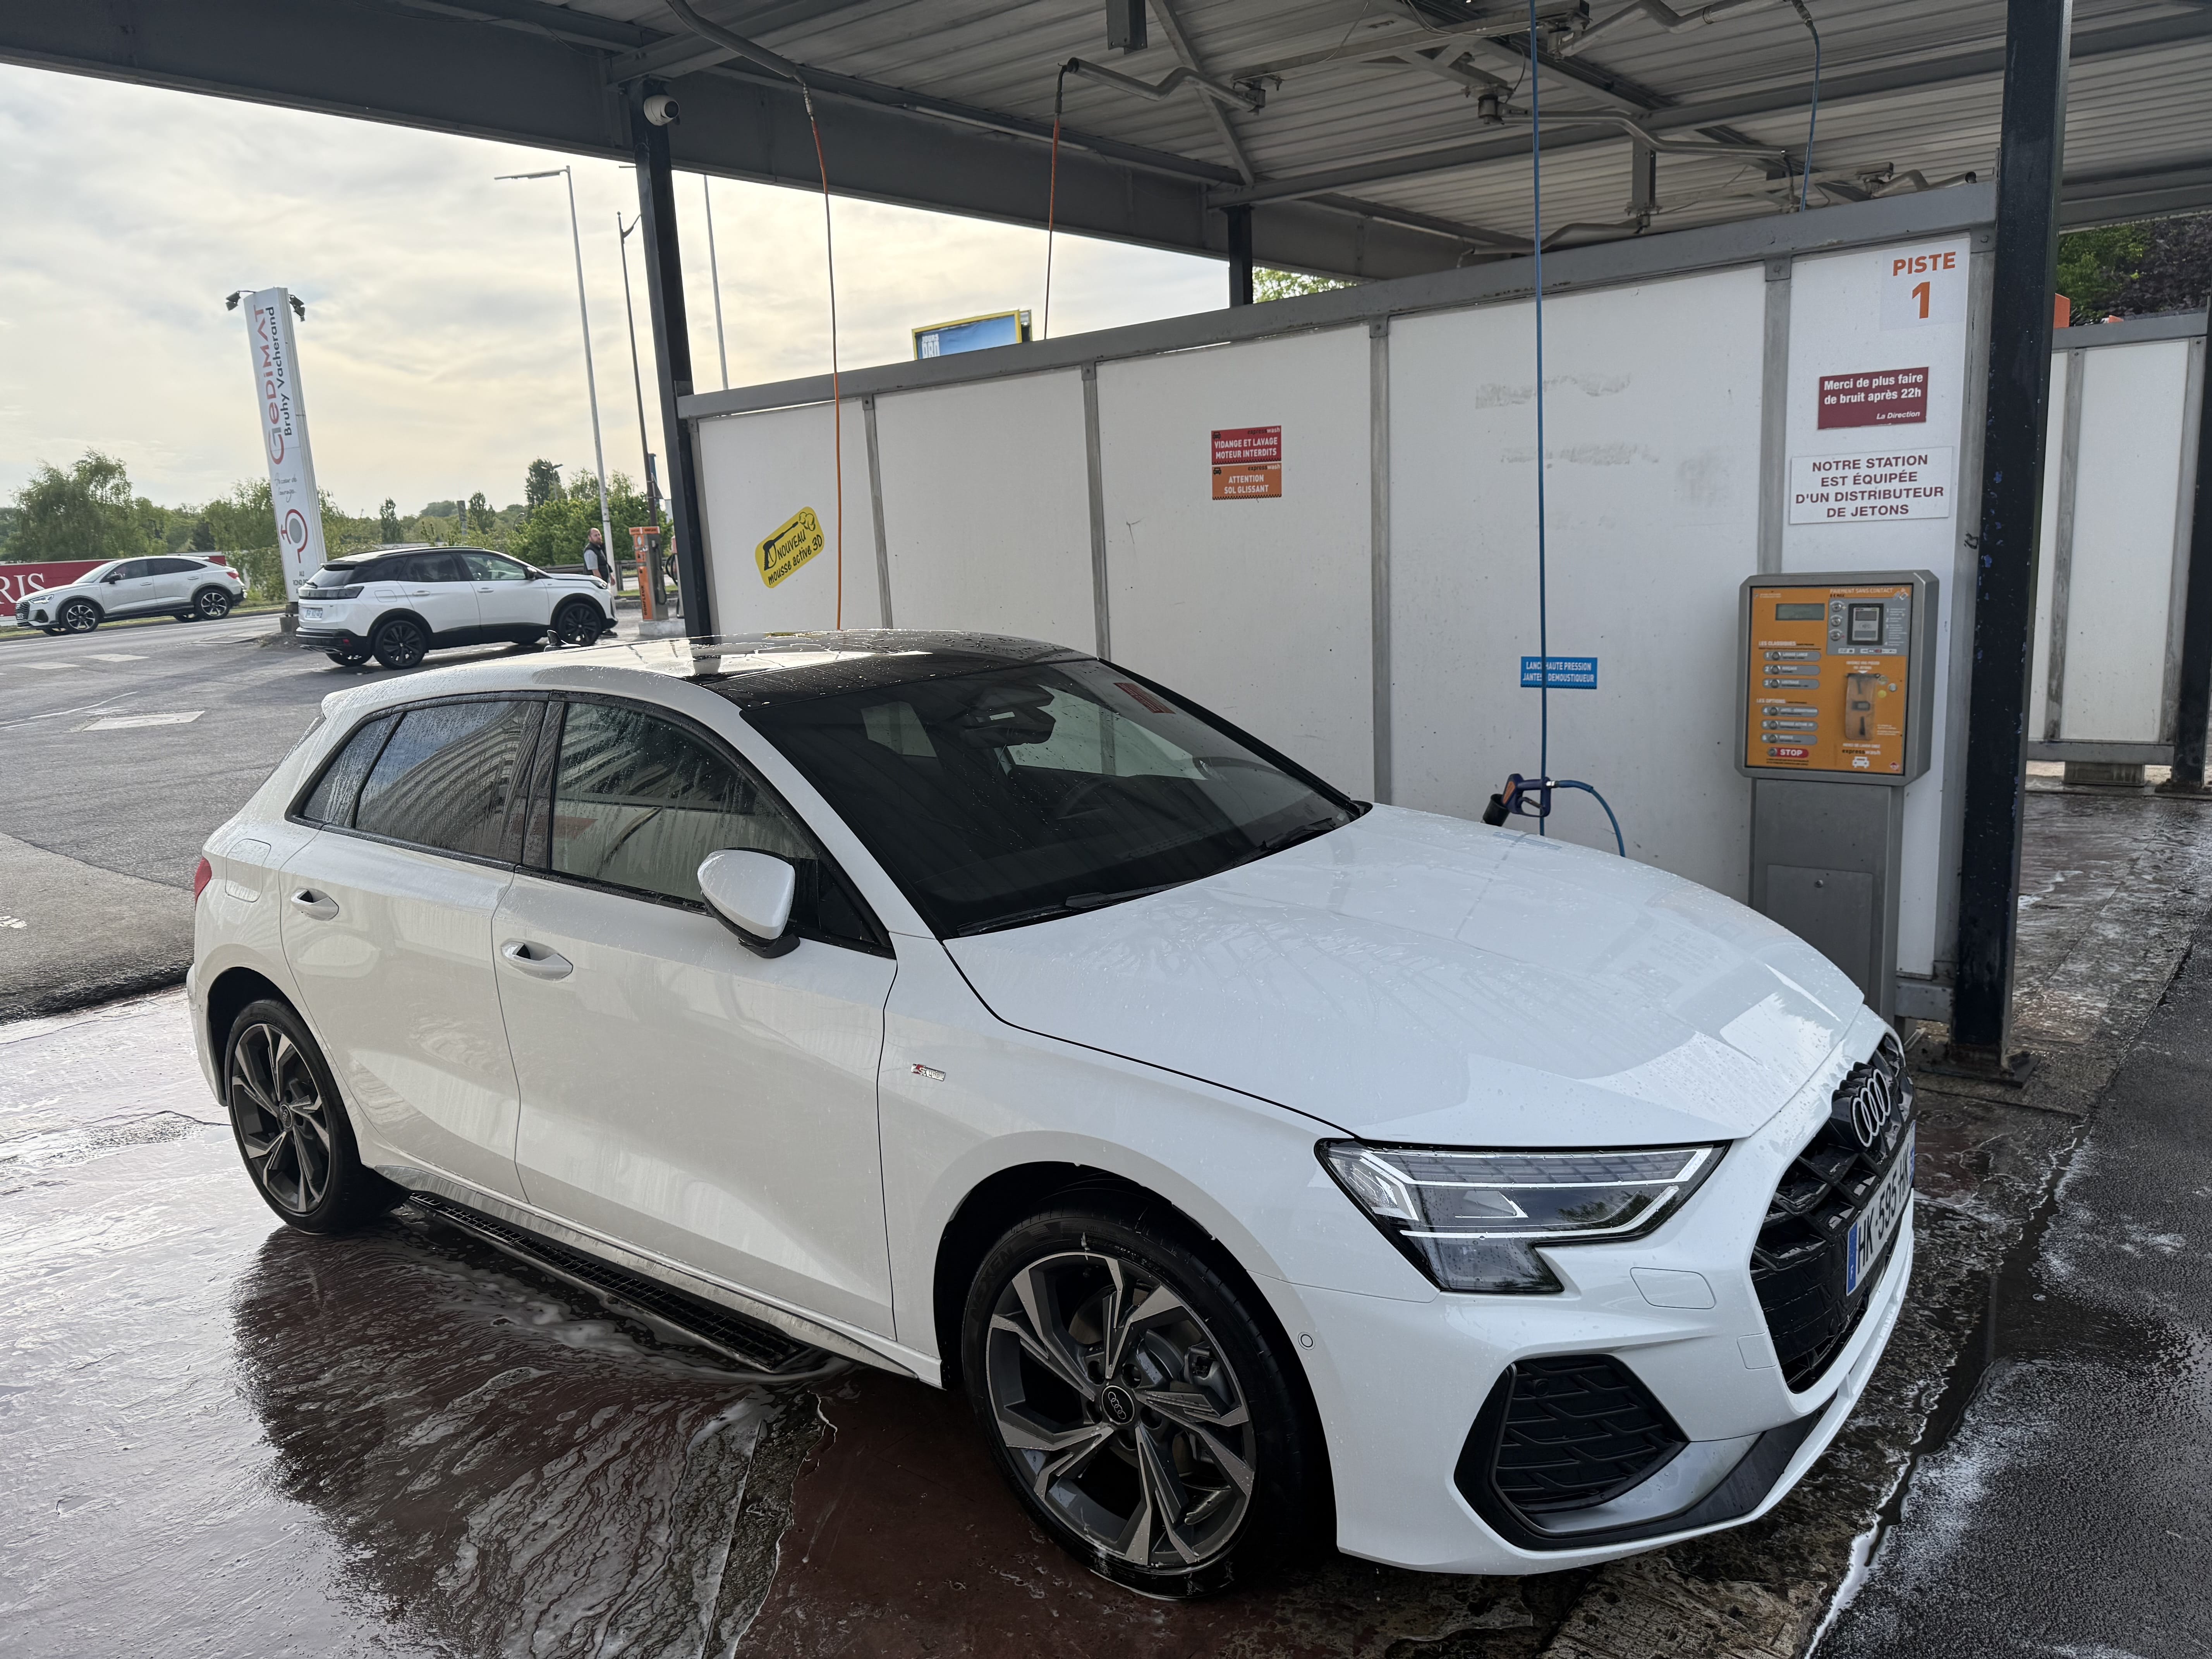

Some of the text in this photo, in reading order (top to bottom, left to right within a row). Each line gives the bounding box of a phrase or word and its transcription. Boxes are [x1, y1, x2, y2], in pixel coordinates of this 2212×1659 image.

[1893, 252, 1956, 276] PISTE
[1912, 282, 1930, 319] 1
[265, 306, 292, 436] Bruhy Vacherand
[1824, 373, 1923, 391] Merci de plus faire
[1824, 388, 1922, 405] de bruit après 22h
[1887, 410, 1920, 419] Direction
[1214, 437, 1278, 448] VIDANGE ET LAVAGE
[1216, 448, 1277, 459] MOTEUR INTERDITS
[1812, 454, 1928, 472] NOTRE STATION
[1228, 474, 1264, 483] ATTENTION
[1821, 469, 1918, 487] EST ÉQUIPÉE
[1237, 484, 1269, 493] GLISSANT
[1796, 486, 1944, 503] D'UN DISTRIBUTEUR
[1827, 504, 1909, 518] DE JETONS
[777, 529, 806, 560] NOUVEAU
[768, 534, 822, 585] mousse active 3D
[1526, 661, 1542, 670] LANC
[1564, 662, 1591, 671] PRESSION
[1548, 674, 1594, 682] DEMOUSTIQUEUR
